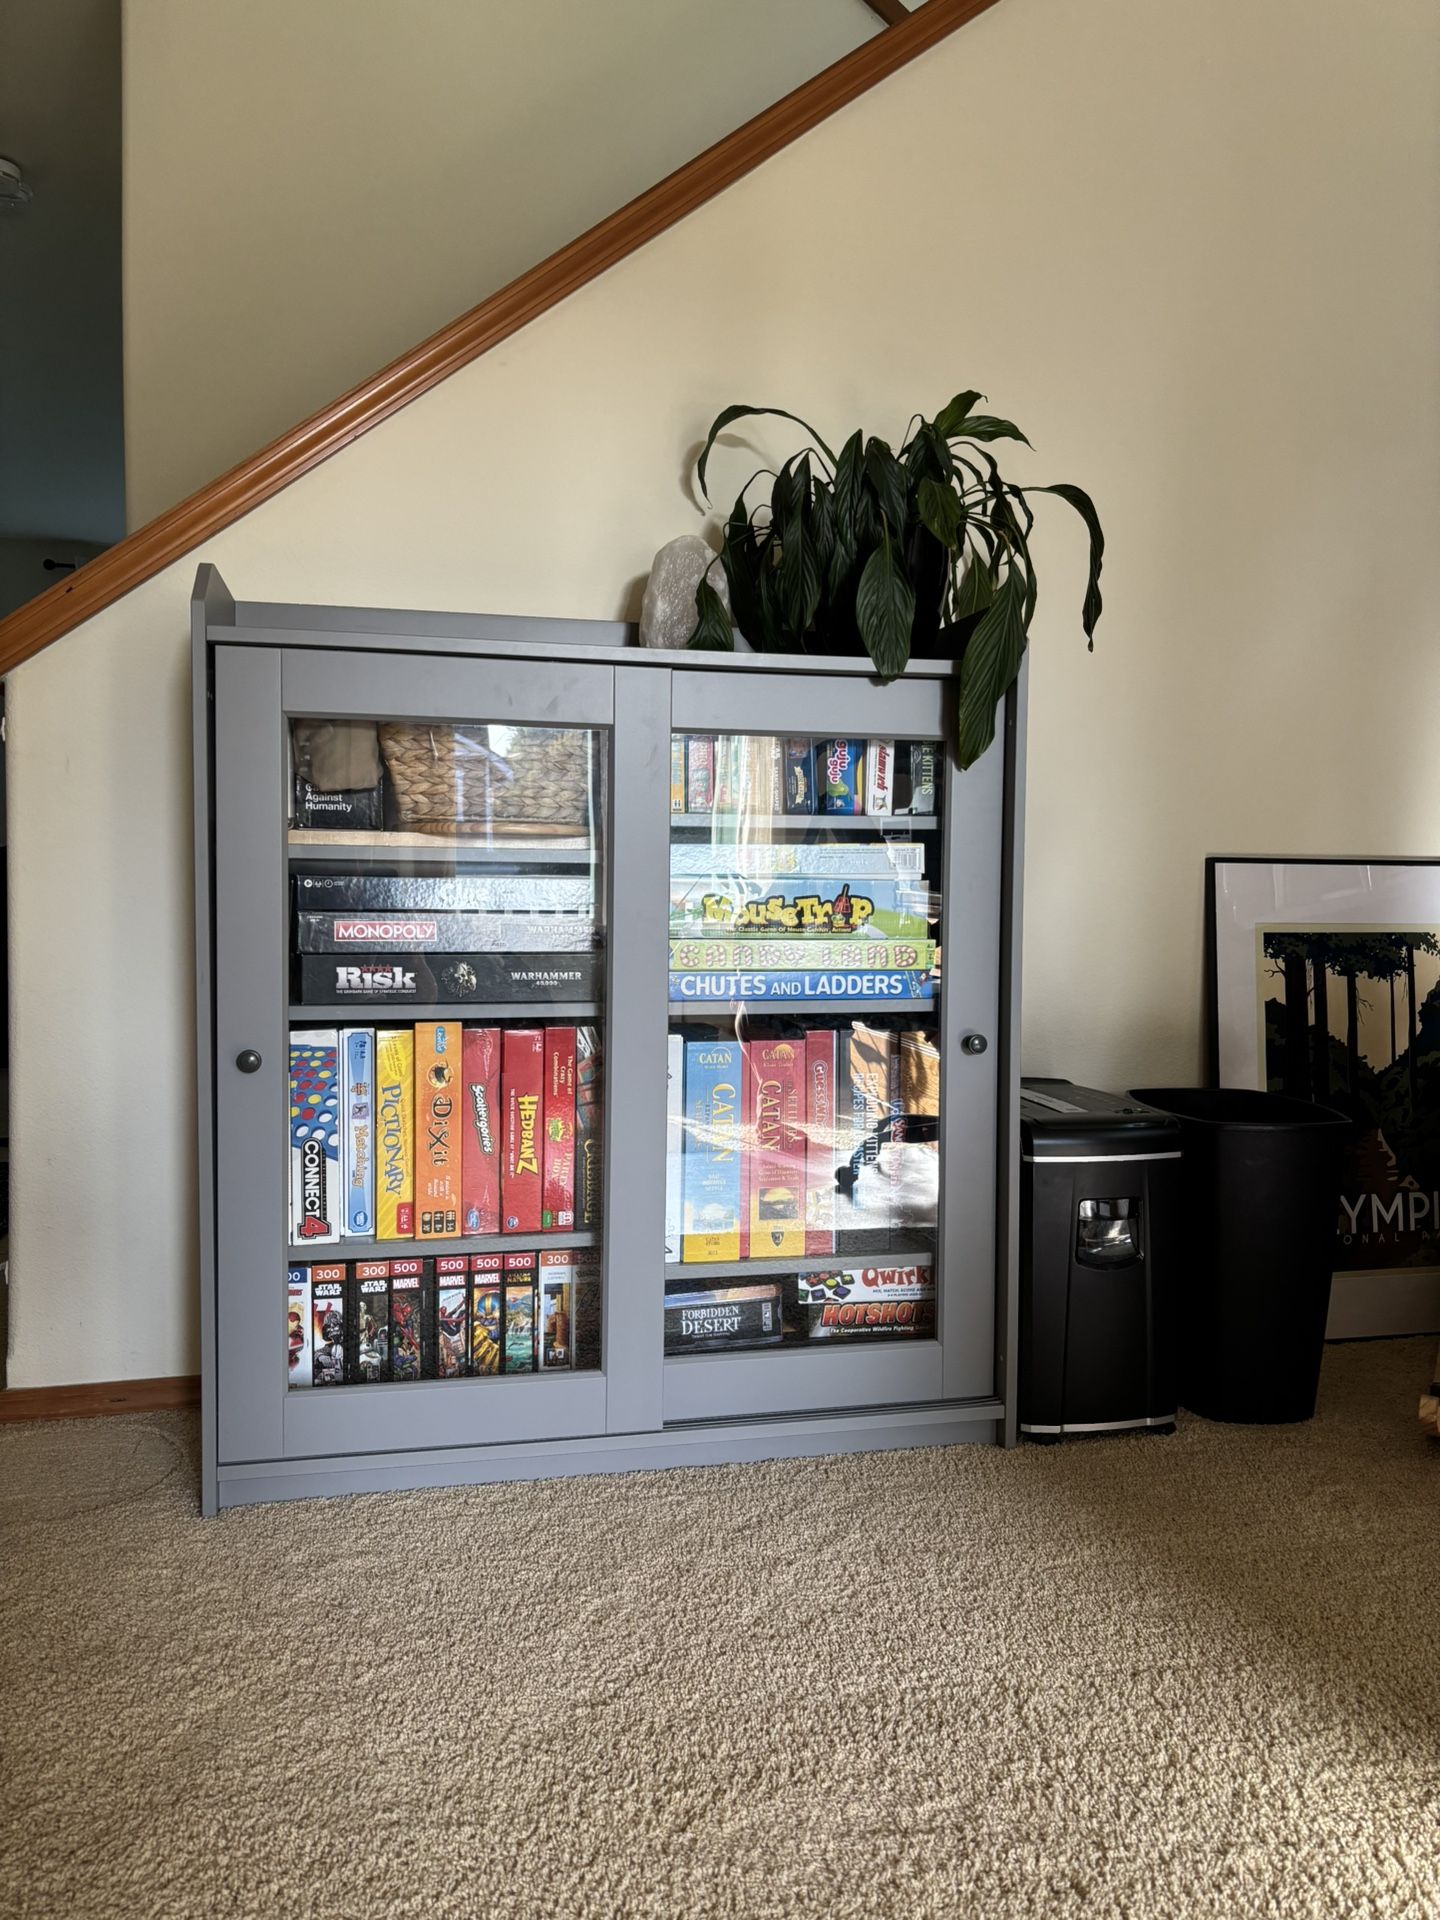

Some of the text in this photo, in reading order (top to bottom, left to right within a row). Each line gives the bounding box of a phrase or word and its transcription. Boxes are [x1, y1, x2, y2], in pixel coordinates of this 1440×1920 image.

[829, 759, 839, 783] guju
[921, 755, 934, 795] KITTENS
[305, 792, 343, 803] Against
[305, 801, 352, 813] Humanity
[338, 924, 434, 938] MONOPOLY
[680, 944, 919, 968] CANDY LAND
[336, 966, 416, 989] Risk
[511, 972, 581, 980] WARHAMMER
[680, 974, 903, 995] CHUTES AND LADDERS
[699, 1052, 732, 1064] CATAN
[762, 1048, 794, 1061] CATAN
[472, 1084, 493, 1153] Scattergories
[761, 1079, 781, 1151] CATAN
[787, 1088, 798, 1143] SETTLRS
[711, 1083, 736, 1162] CATAN
[380, 1083, 404, 1196] PICTIONARY
[516, 1094, 539, 1175] HEDBANZ
[352, 1125, 369, 1187] Matching
[552, 1158, 562, 1179] BOX
[559, 1152, 573, 1187] PARTY
[300, 1140, 329, 1237] CONNECT 4
[1339, 1191, 1440, 1234] YMPI
[1343, 1232, 1400, 1245] ONAL
[440, 1260, 464, 1271] 500
[476, 1258, 499, 1269] 500
[508, 1257, 531, 1267] 500
[546, 1254, 569, 1264] 300
[316, 1269, 340, 1279] 300
[362, 1266, 386, 1277] 300
[394, 1263, 417, 1273] 500
[392, 1277, 420, 1290] MARVEL
[439, 1274, 466, 1287] MARVEL
[474, 1272, 500, 1285] MARVEL
[315, 1287, 341, 1297] WARS
[317, 1283, 342, 1291] STAR
[361, 1284, 387, 1294] WARS
[681, 1305, 739, 1320] FORBIDDEN
[821, 1301, 934, 1327] HOTSHOTS
[681, 1316, 742, 1336] DESERT
